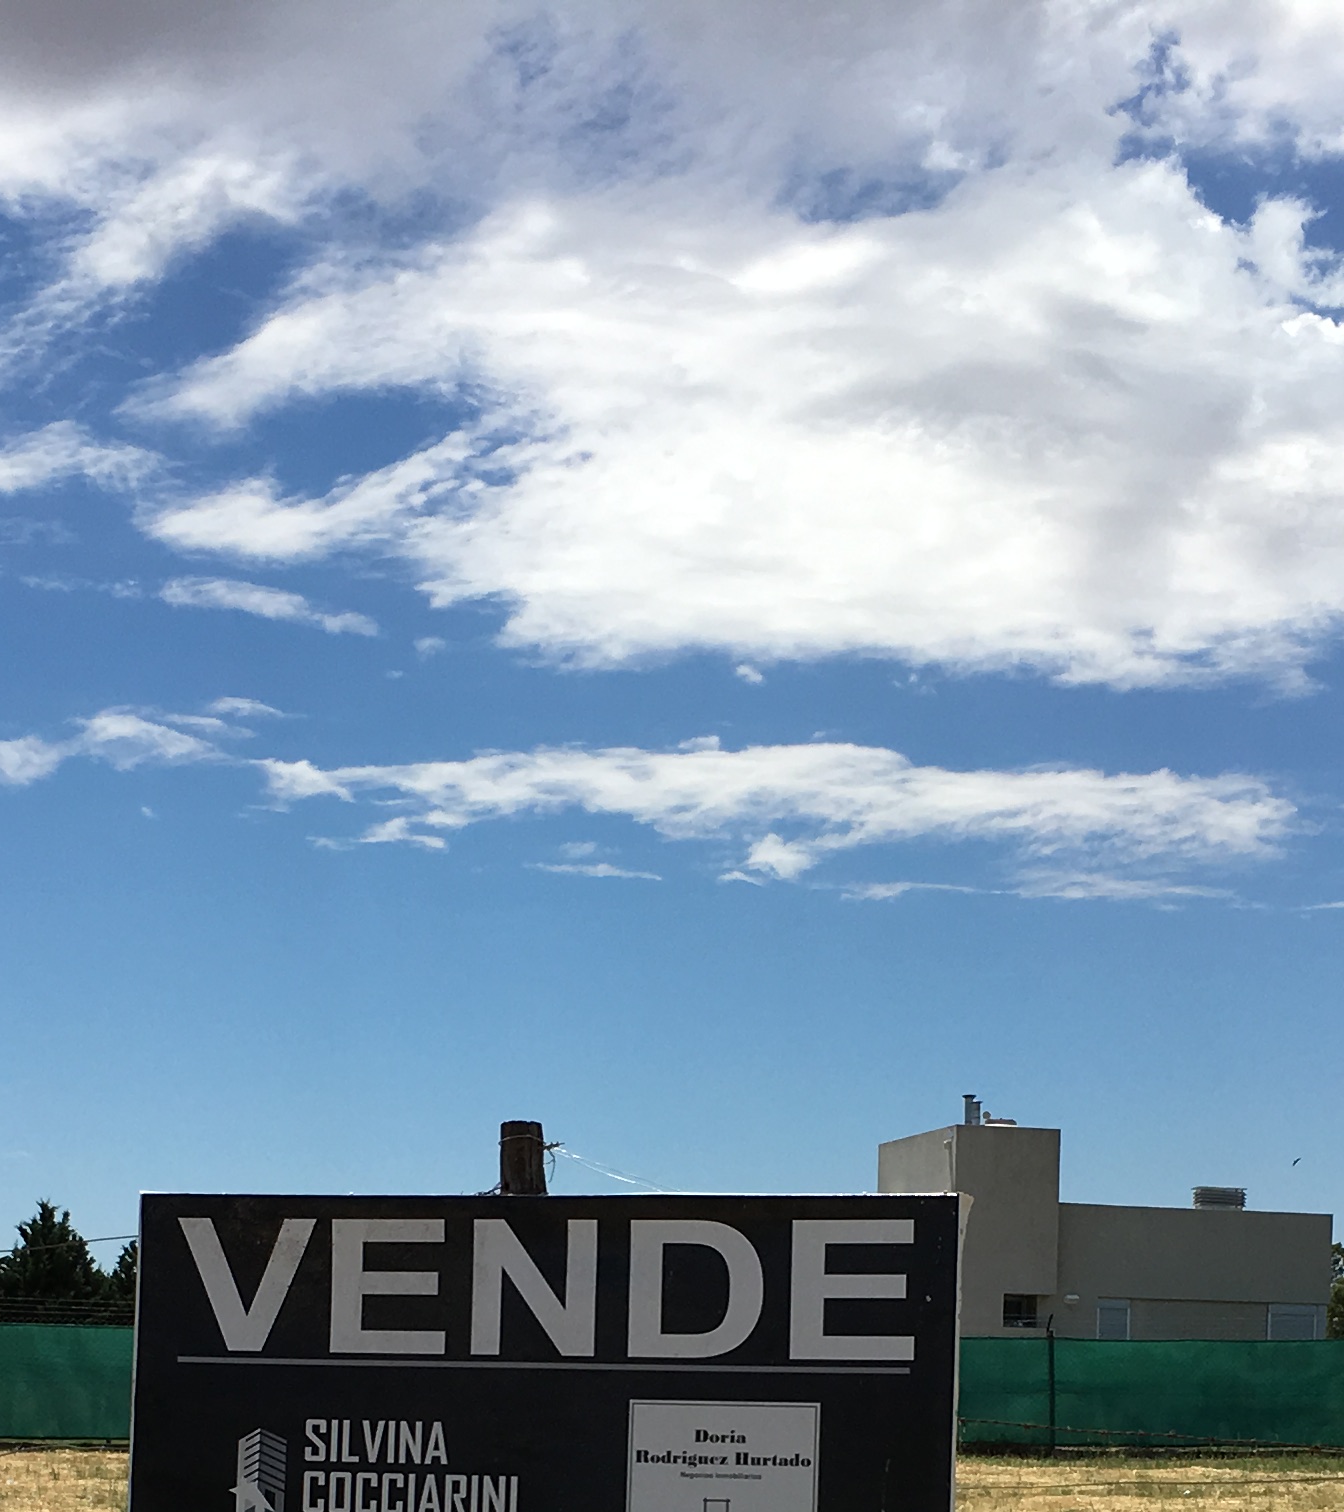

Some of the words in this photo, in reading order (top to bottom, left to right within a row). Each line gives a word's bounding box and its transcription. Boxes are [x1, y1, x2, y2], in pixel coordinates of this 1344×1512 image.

[177, 1217, 915, 1361] VENDE
[305, 1418, 449, 1465] SILVINA
[735, 1452, 812, 1468] Hurtado
